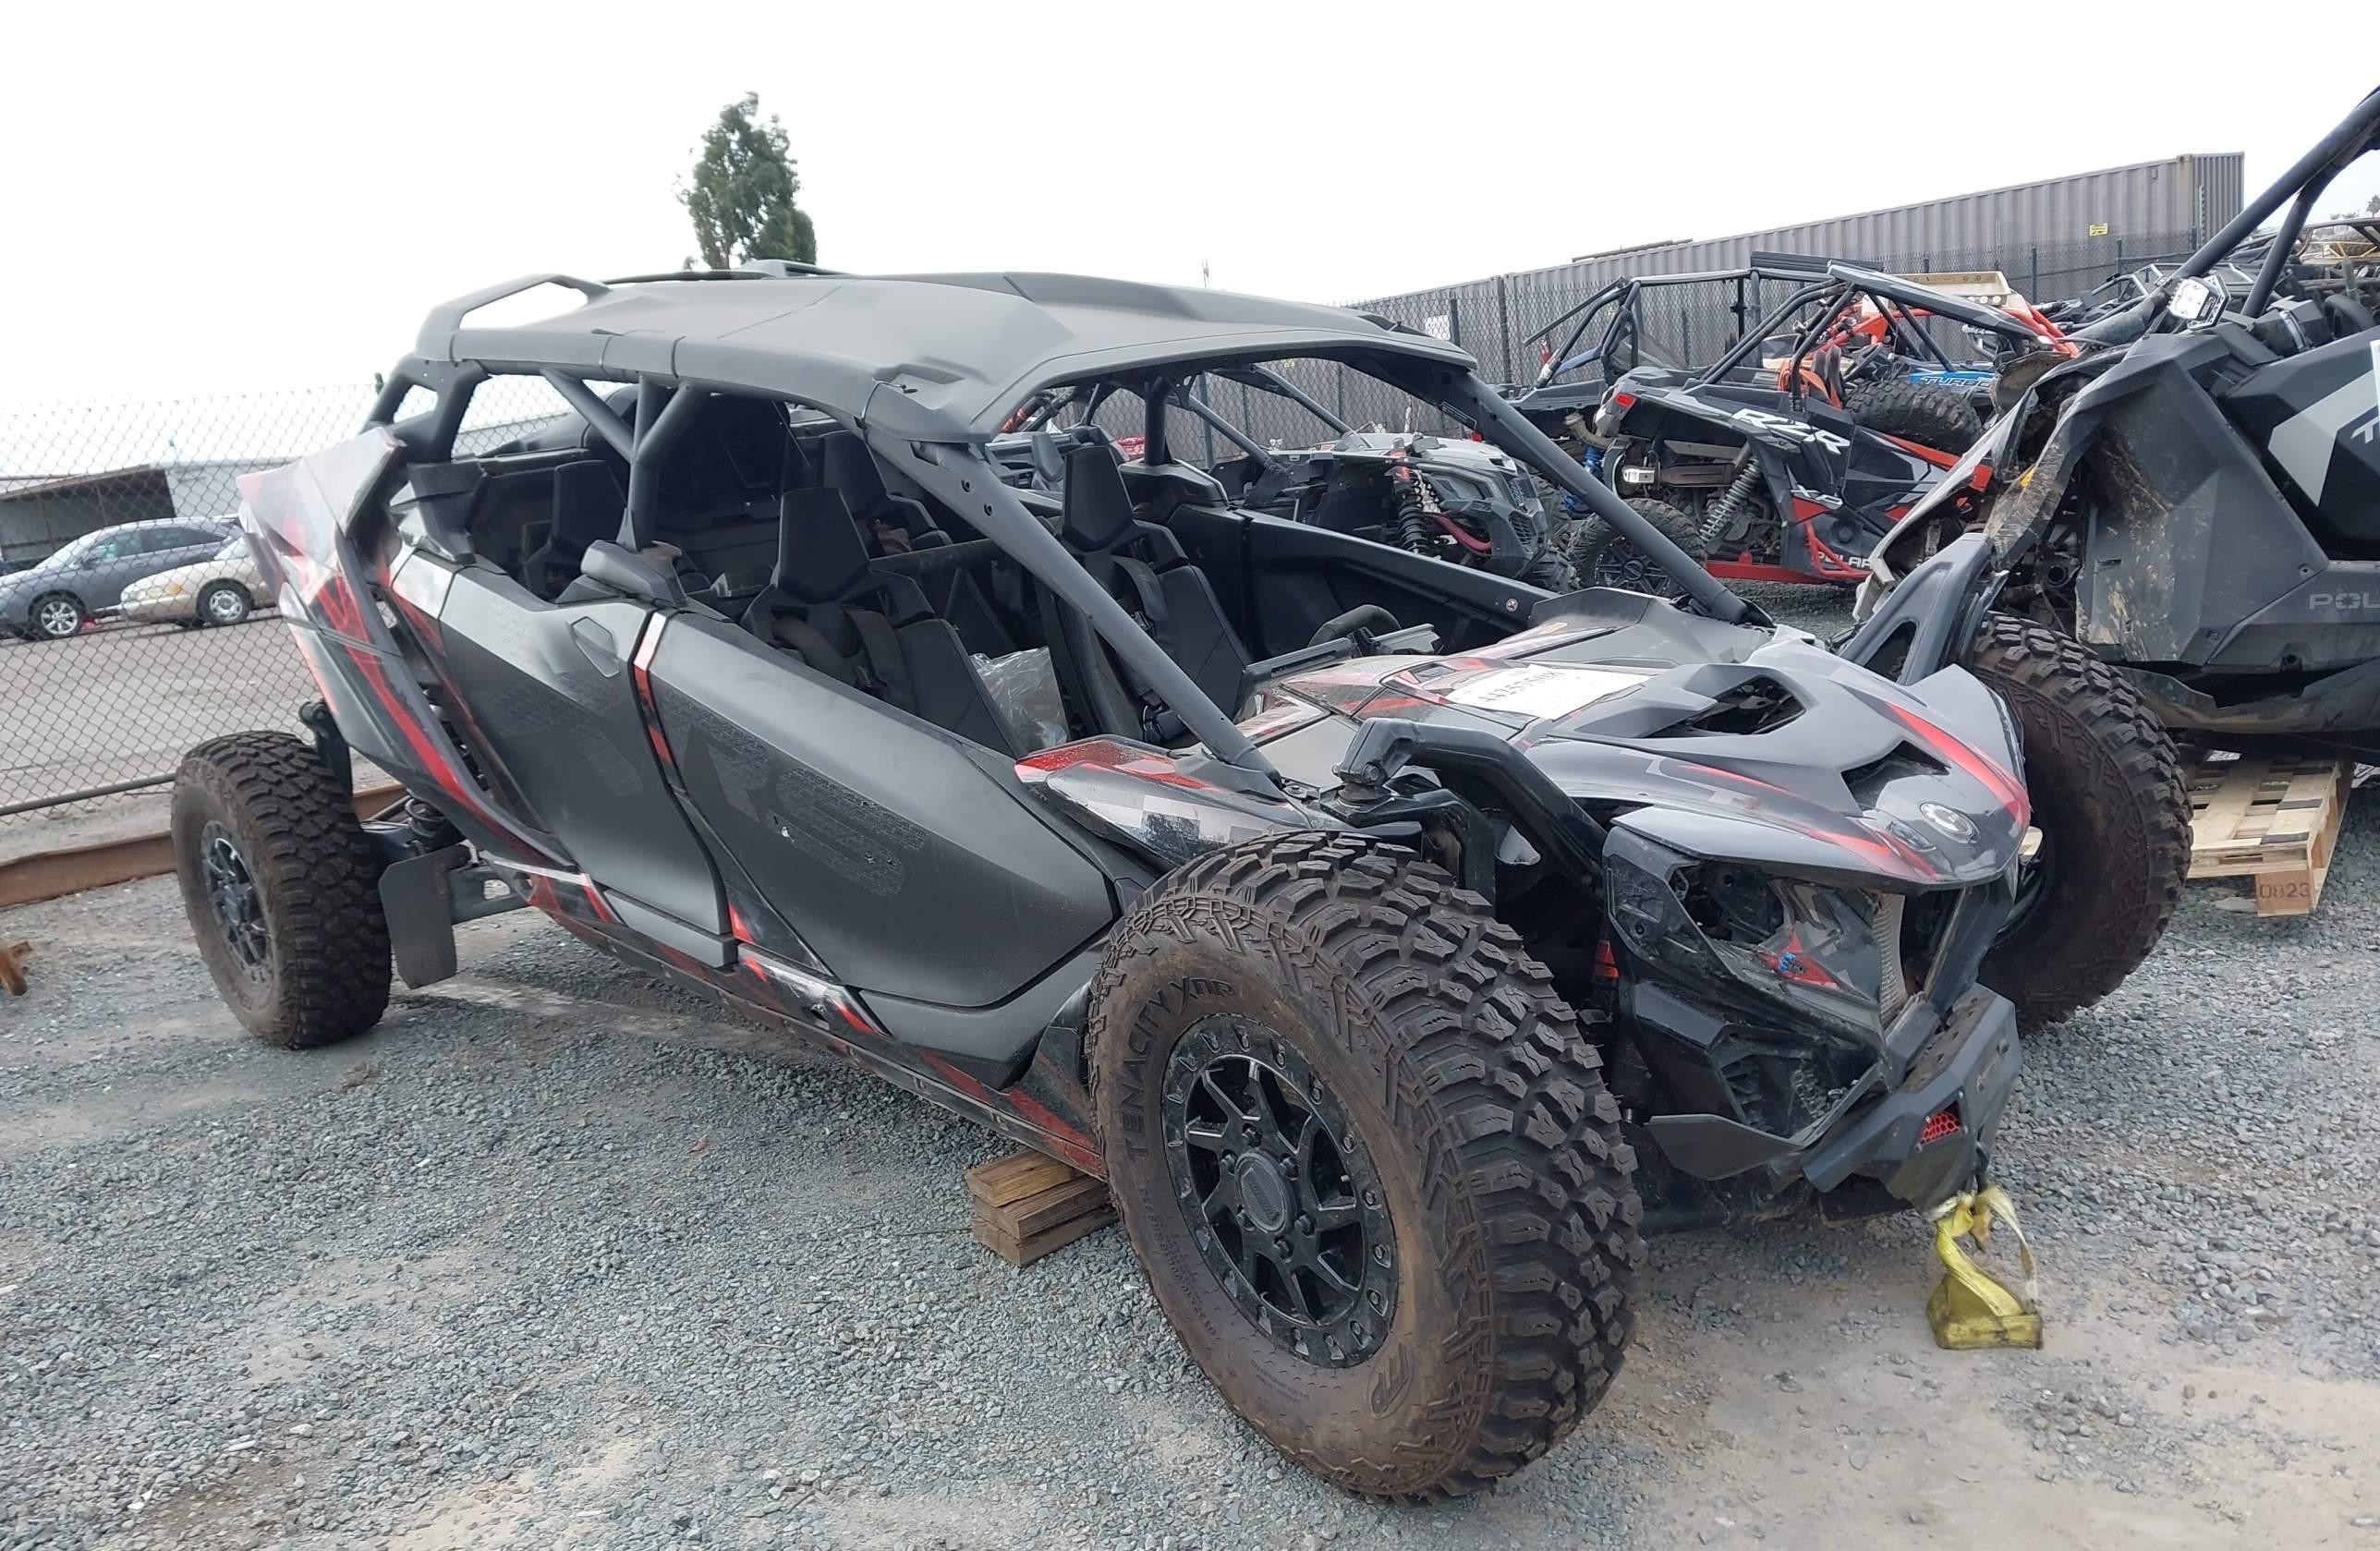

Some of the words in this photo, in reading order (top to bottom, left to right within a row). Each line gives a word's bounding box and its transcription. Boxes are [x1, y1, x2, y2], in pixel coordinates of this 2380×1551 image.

[1731, 408, 1851, 454] RZR
[1791, 485, 1844, 509] XP
[2309, 592, 2380, 610] POL
[2259, 881, 2311, 899] 0823
[1121, 989, 1172, 1158] TENACITY
